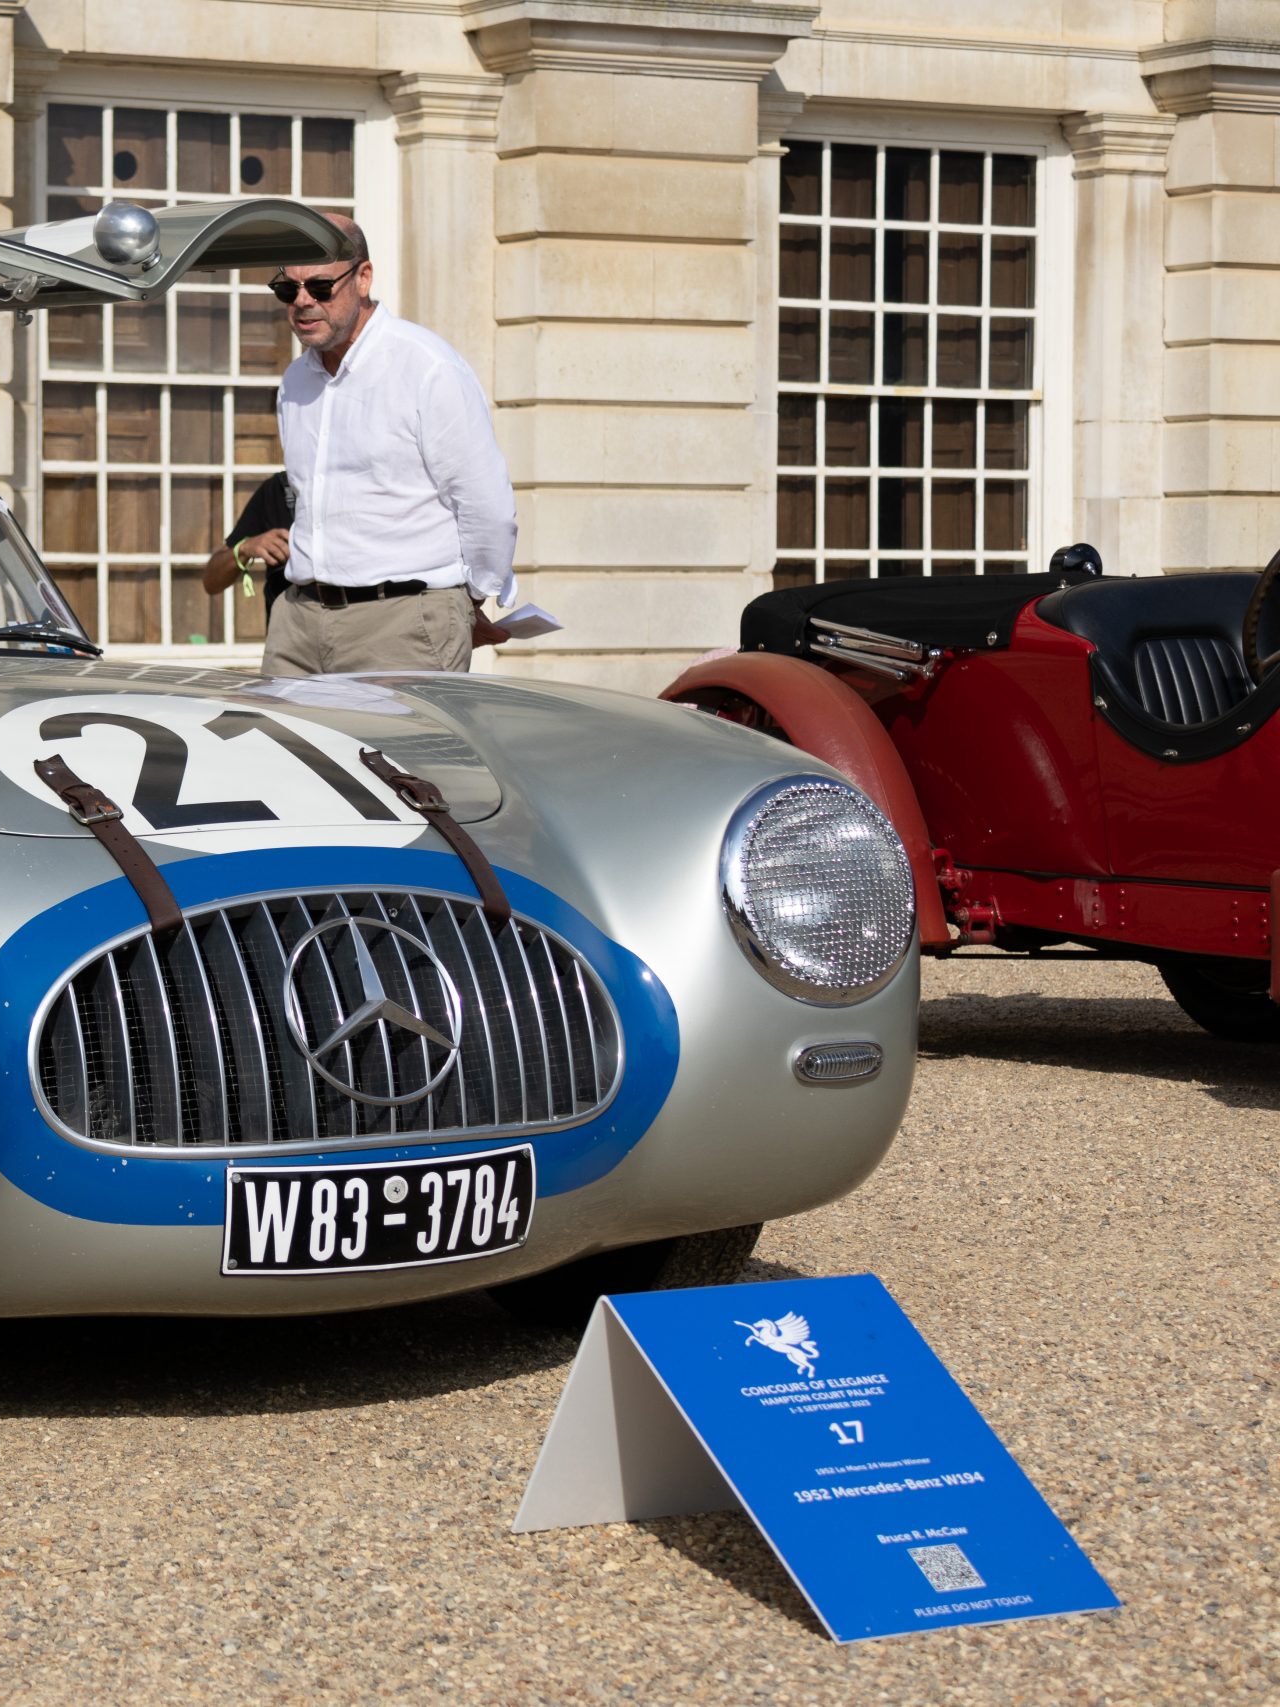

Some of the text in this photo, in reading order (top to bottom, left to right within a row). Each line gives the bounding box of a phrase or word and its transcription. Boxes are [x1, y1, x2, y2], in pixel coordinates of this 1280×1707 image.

[39, 710, 401, 830] 21
[740, 1374, 889, 1397] CONCOURS OF ELEGANCE
[760, 1386, 885, 1406] HAMPTON COURT PALACE
[802, 1401, 851, 1412] SEPTEMBER
[850, 1399, 871, 1408] 2023
[829, 1420, 864, 1445] 17
[815, 1467, 835, 1476] 1952
[845, 1464, 867, 1472] Mans
[793, 1471, 985, 1503] 1952 Mercedes-Benz W194
[876, 1526, 968, 1545] Bruce R. McCaw
[913, 1595, 1033, 1618] PLEASE DO NOT TOUCH
